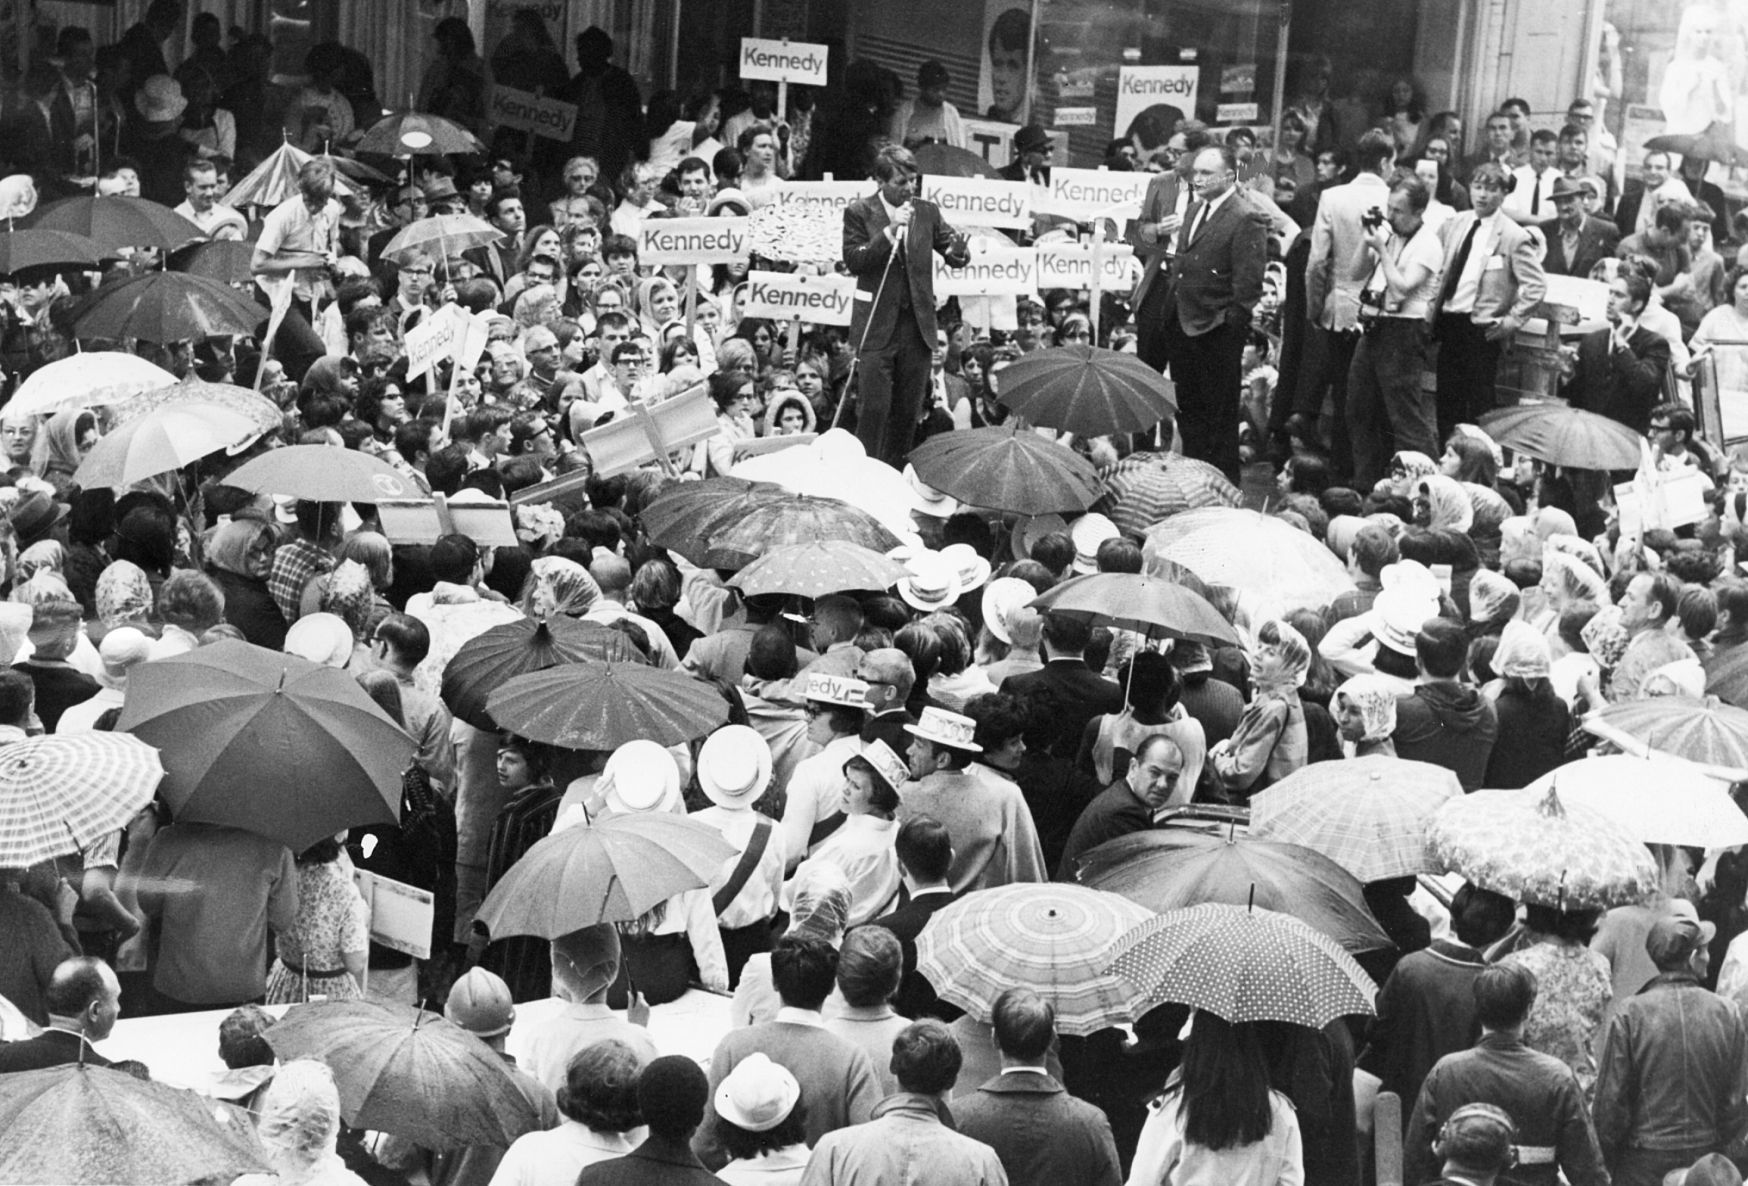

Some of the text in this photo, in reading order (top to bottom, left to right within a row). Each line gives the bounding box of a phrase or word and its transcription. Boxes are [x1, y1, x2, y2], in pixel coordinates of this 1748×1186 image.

[744, 47, 824, 75] Kennedy
[1122, 73, 1194, 97] Kennedy
[494, 92, 572, 133] Kennedy
[926, 187, 1025, 218] Kennedy
[645, 228, 744, 254] Kennedy
[1042, 253, 1128, 279] Kenndy
[750, 282, 850, 314] Kennedy
